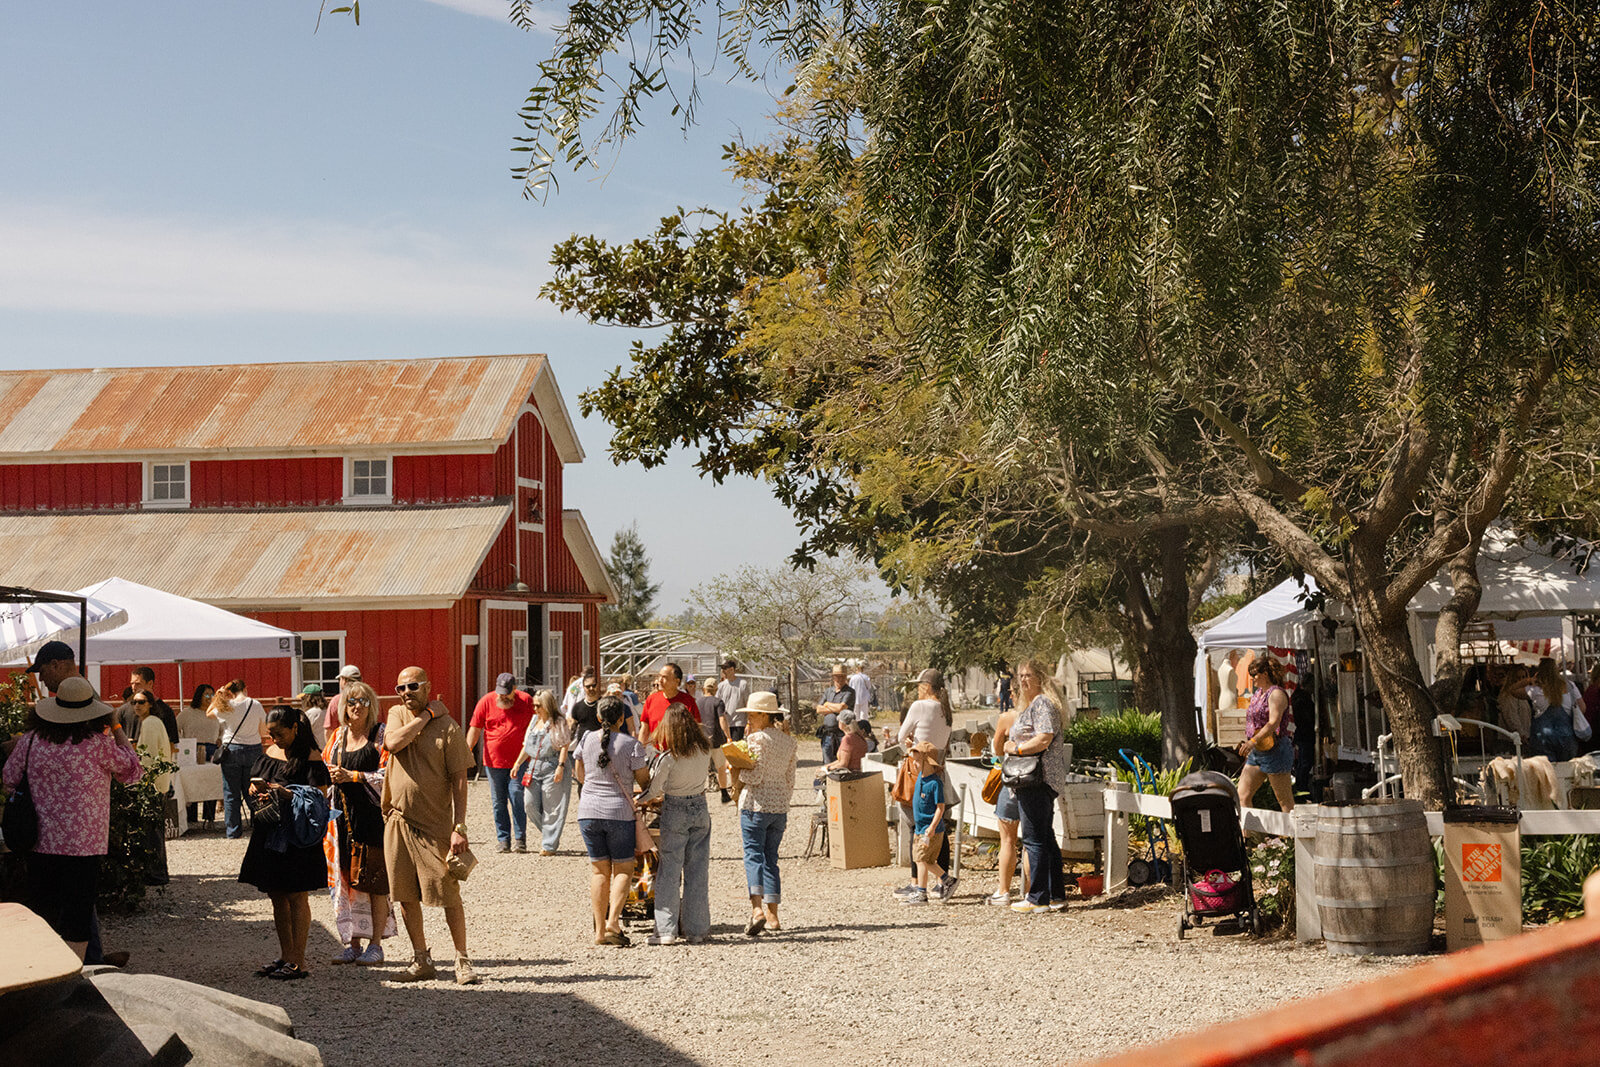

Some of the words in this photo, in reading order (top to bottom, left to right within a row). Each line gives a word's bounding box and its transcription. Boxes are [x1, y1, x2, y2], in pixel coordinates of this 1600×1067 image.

[1463, 843, 1501, 881] HOME
[1467, 848, 1481, 862] THE
[1478, 858, 1502, 882] DEPOT
